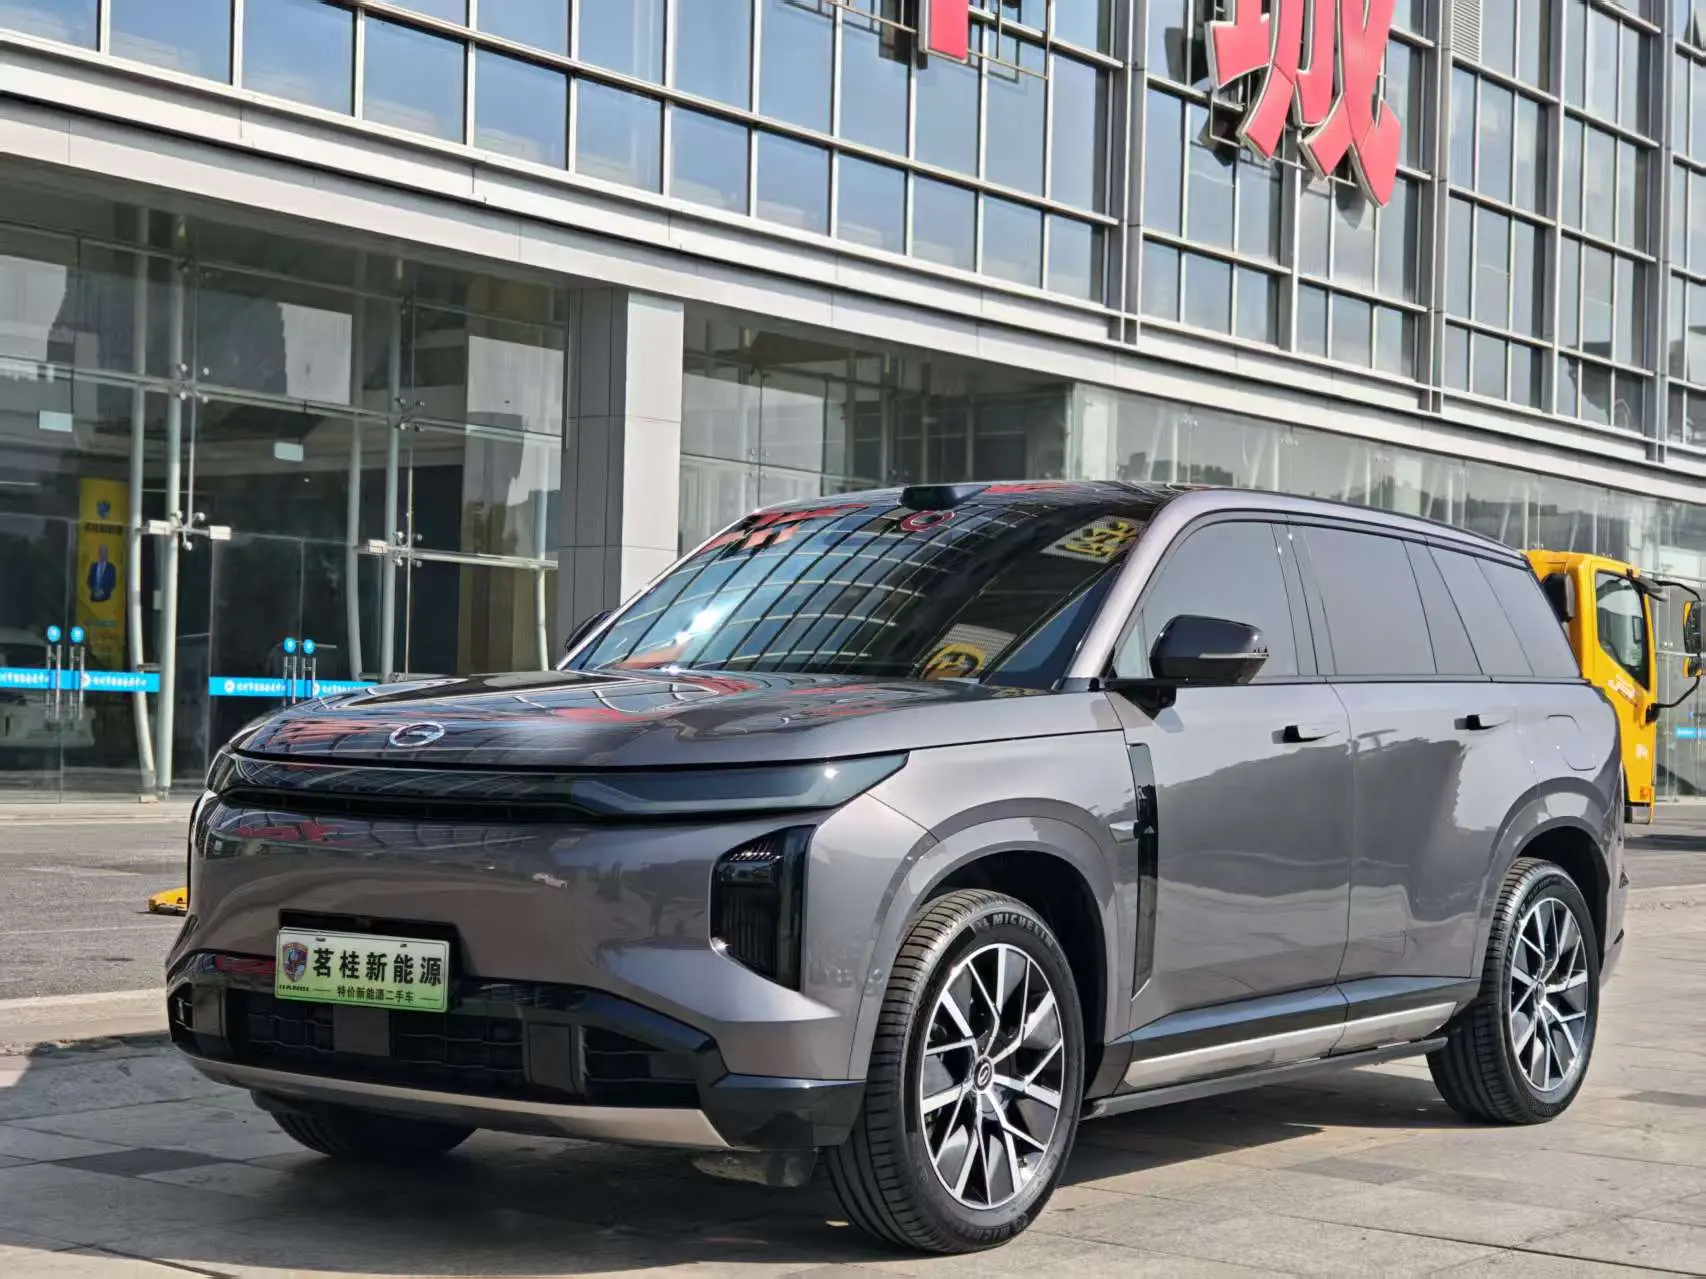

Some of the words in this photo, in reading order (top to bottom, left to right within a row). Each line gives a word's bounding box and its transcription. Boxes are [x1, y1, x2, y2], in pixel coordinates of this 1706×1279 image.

[992, 913, 1054, 948] MICHELIN
[313, 947, 442, 986] 茗桂新能源
[337, 985, 414, 1003] 特价新能源二手车
